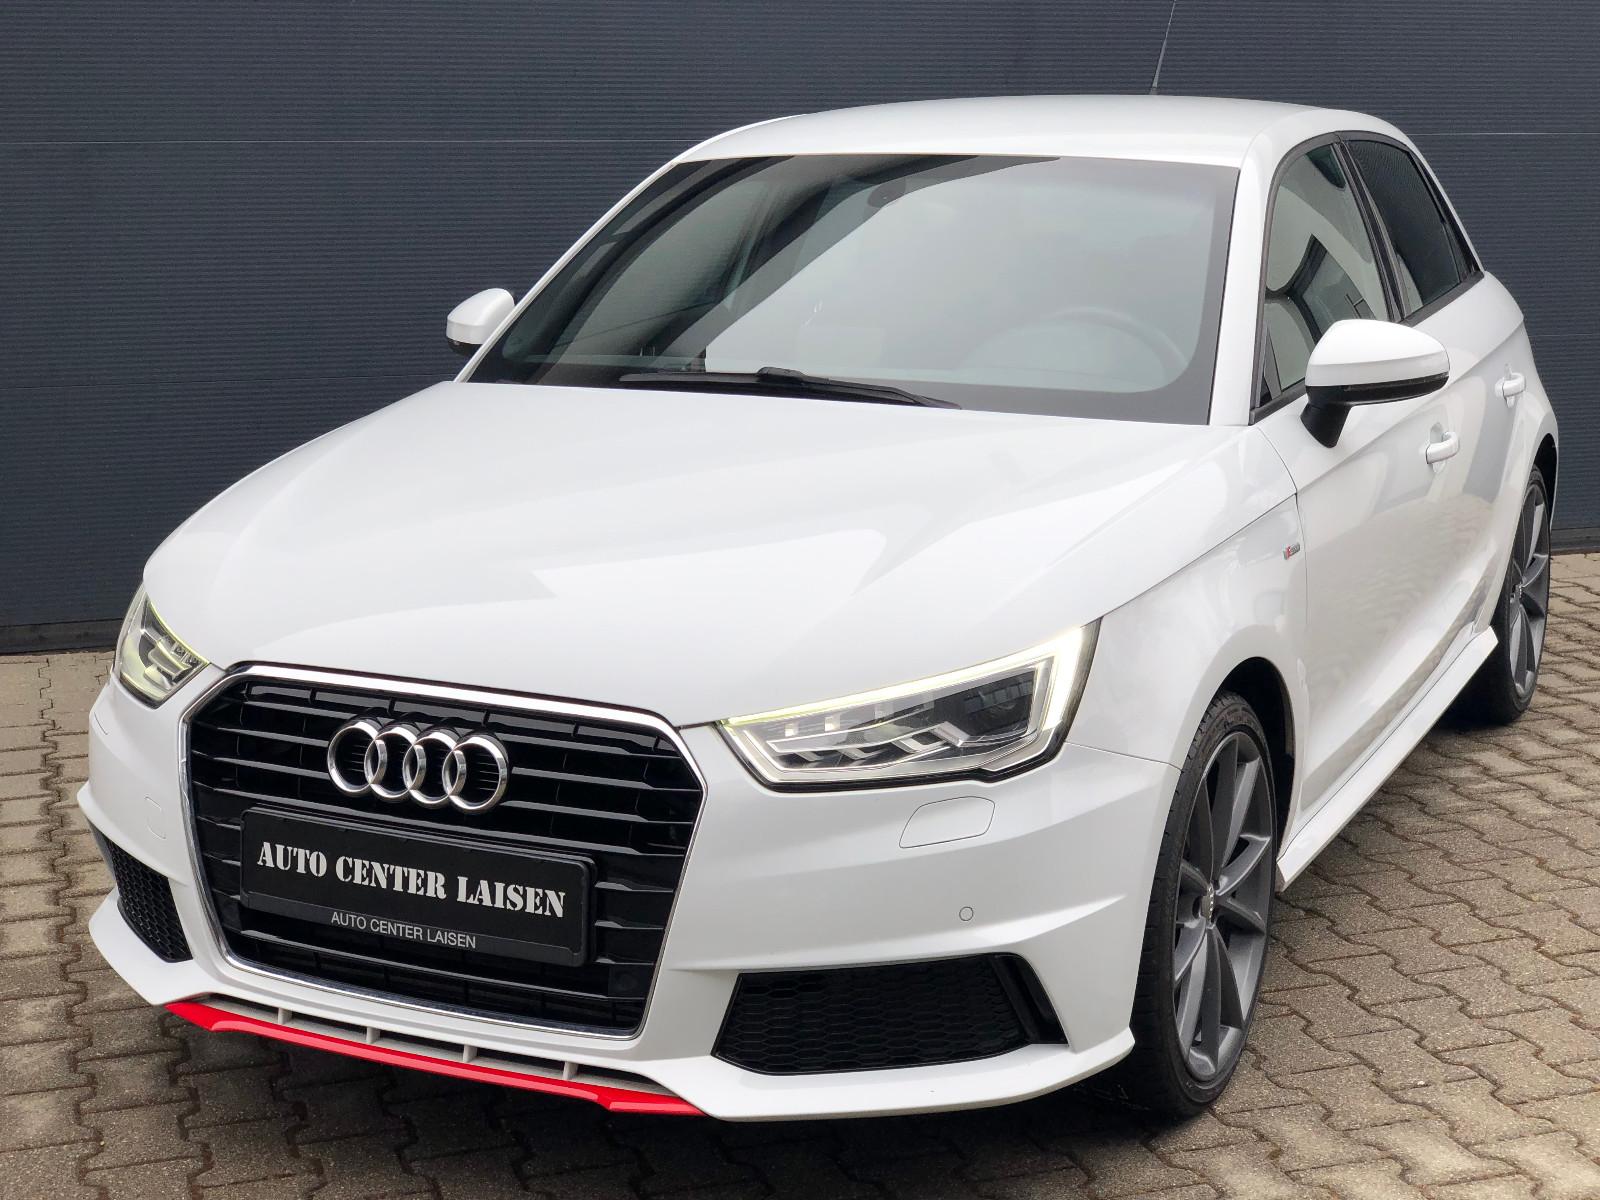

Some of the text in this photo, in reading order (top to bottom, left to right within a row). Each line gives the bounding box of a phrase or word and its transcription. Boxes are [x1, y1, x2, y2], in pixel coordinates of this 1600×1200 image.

[257, 841, 566, 918] AUTO CENTER LAISEN
[331, 911, 476, 949] AUTO CENTER LAISEN
